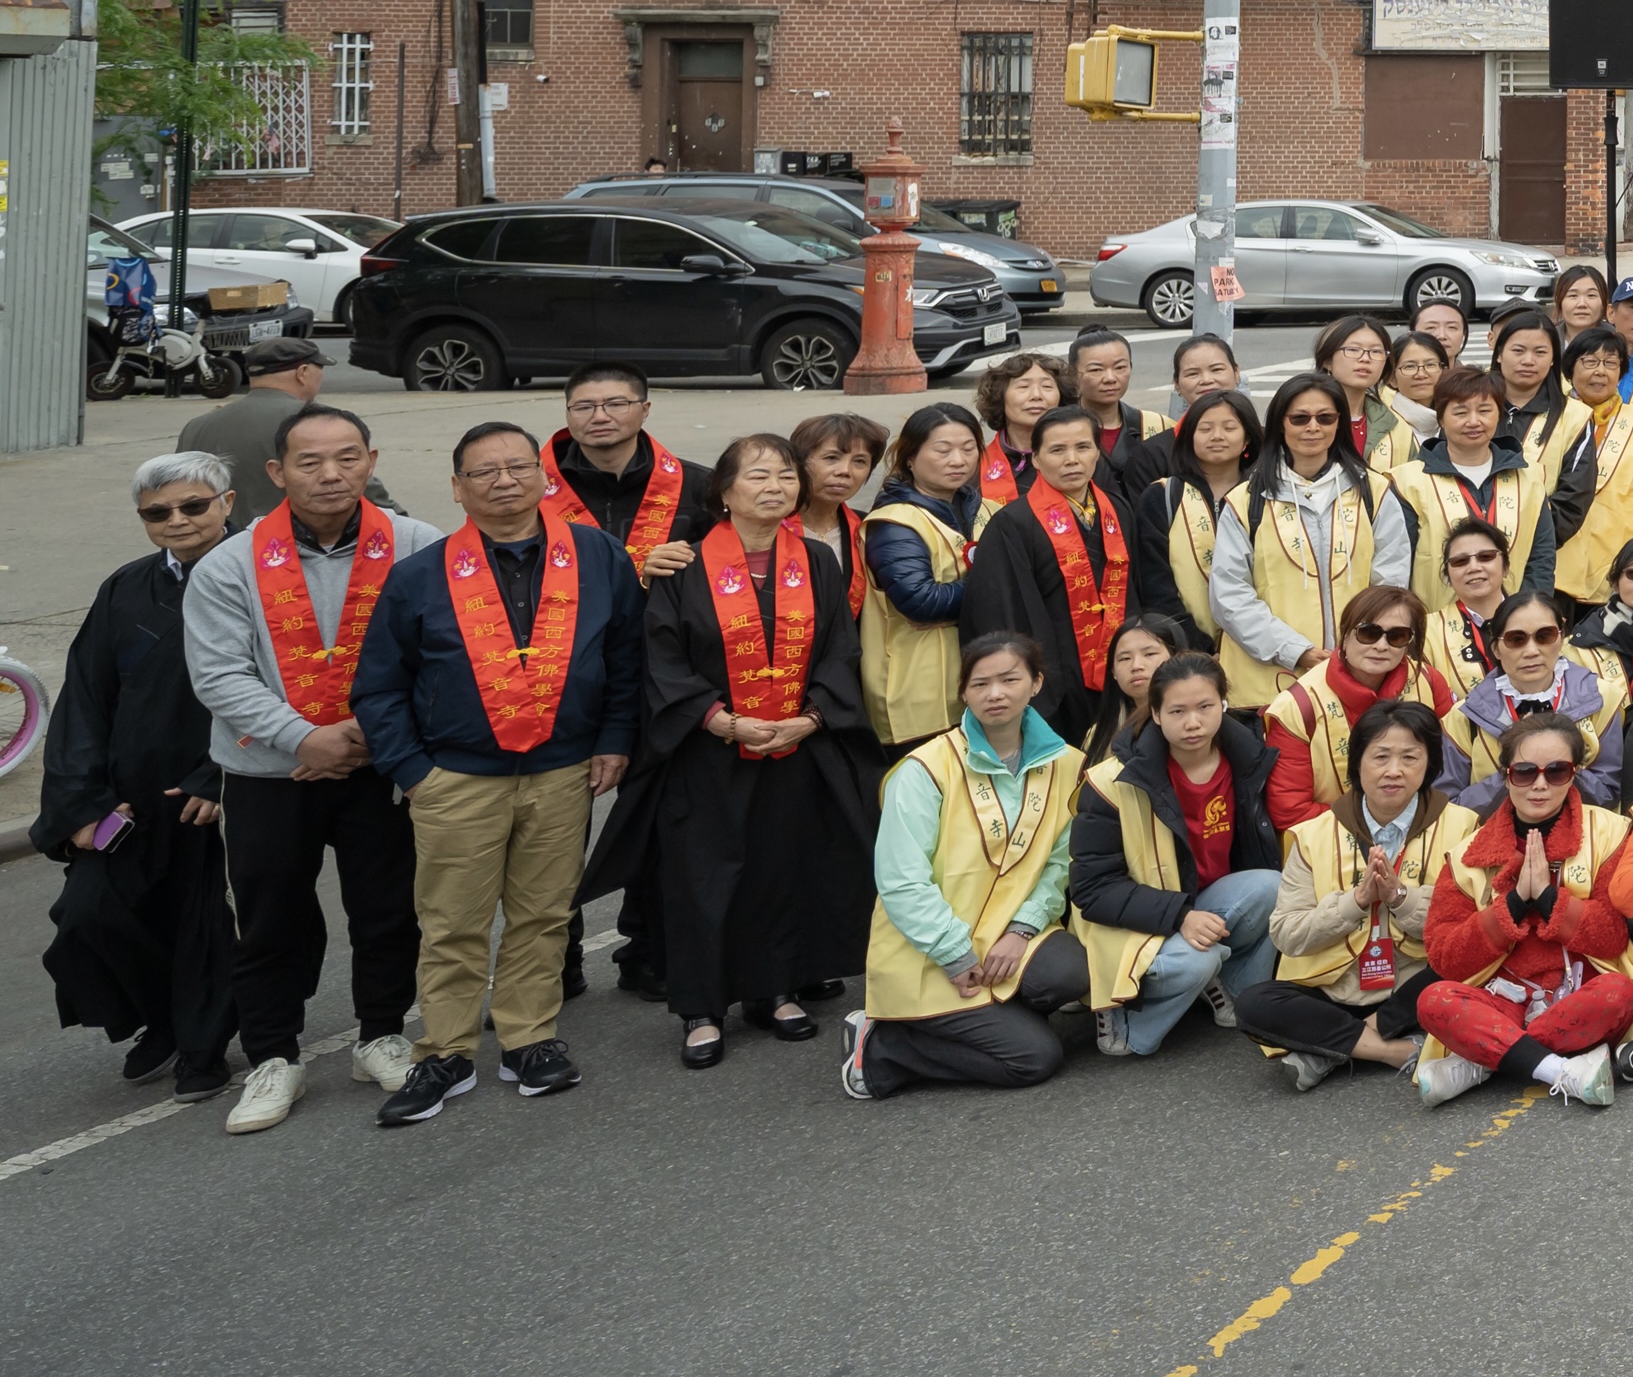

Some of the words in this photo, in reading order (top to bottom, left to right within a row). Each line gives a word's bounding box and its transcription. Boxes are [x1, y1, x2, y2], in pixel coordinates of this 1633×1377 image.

[274, 587, 326, 718] 紐約梵音寺
[464, 596, 523, 721] 紐約梵音寺
[529, 588, 571, 720] 美國西方佛學會
